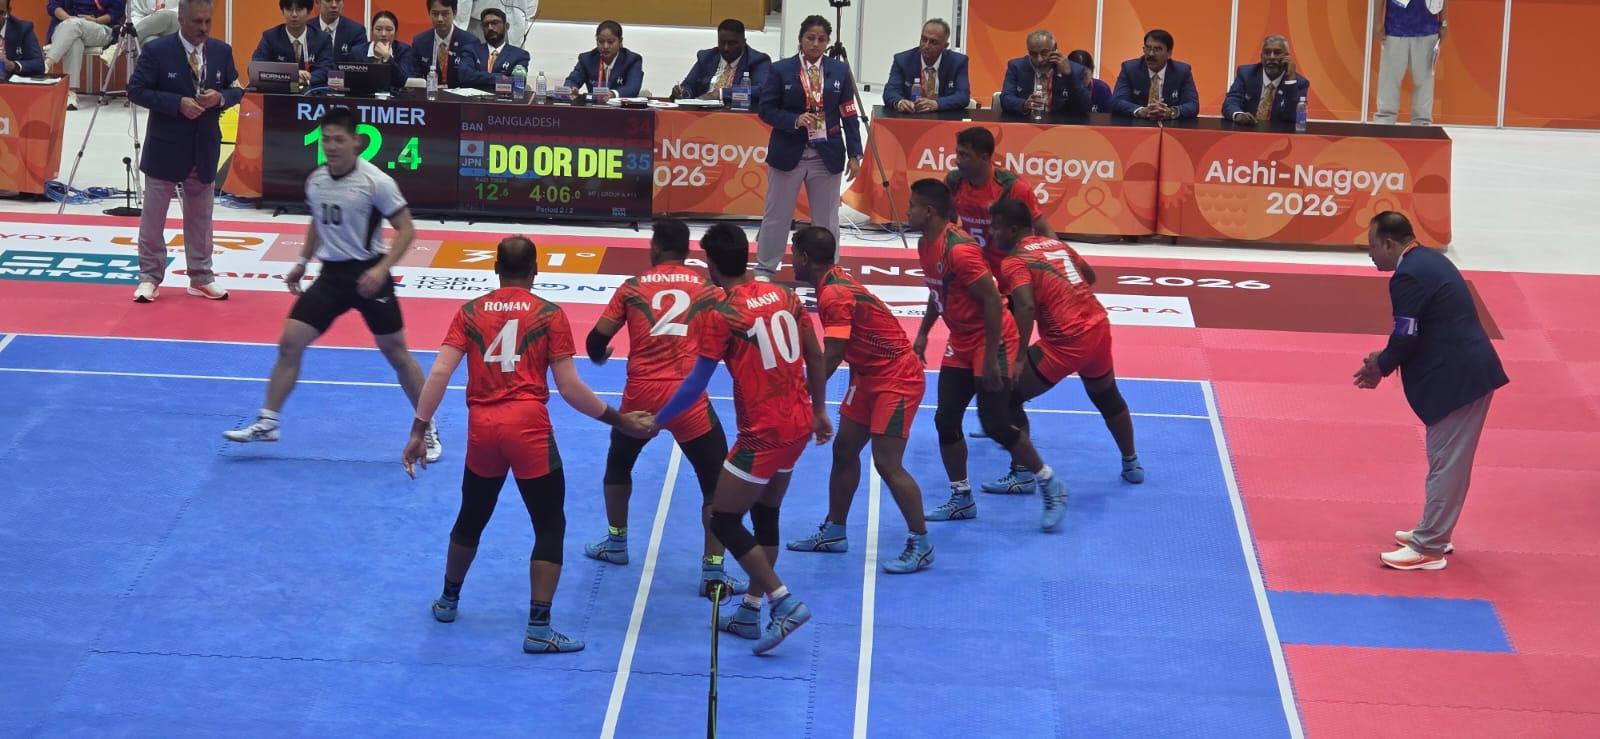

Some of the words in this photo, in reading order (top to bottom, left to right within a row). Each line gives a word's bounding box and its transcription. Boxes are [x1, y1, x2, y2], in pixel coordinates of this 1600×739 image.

[357, 105, 425, 125] TIMER
[487, 115, 561, 129] BANGLADESH
[461, 122, 484, 132] BAN
[461, 158, 482, 167] JPN
[489, 144, 528, 175] DO
[534, 146, 572, 177] OR
[578, 148, 624, 179] DIE
[626, 153, 650, 170] 35
[654, 138, 768, 169] -Nagoya
[917, 148, 1114, 184] Aic-Nagoya
[654, 166, 706, 187] 026
[1205, 158, 1404, 195] Aichi-Nagoya
[321, 203, 342, 225] 10
[1266, 192, 1338, 217] 2026
[0, 234, 91, 242] YOTA
[0, 268, 140, 280] NITOR
[1043, 250, 1082, 284] 7
[416, 275, 488, 283] TOBU
[641, 273, 702, 285] MONIRUL
[1117, 275, 1271, 290] 2026
[483, 301, 531, 312] ROMAN
[746, 292, 780, 310] AKASH
[1105, 305, 1183, 315] OTA
[650, 289, 691, 337] 2
[483, 319, 521, 373] 4
[746, 310, 801, 370] 10
